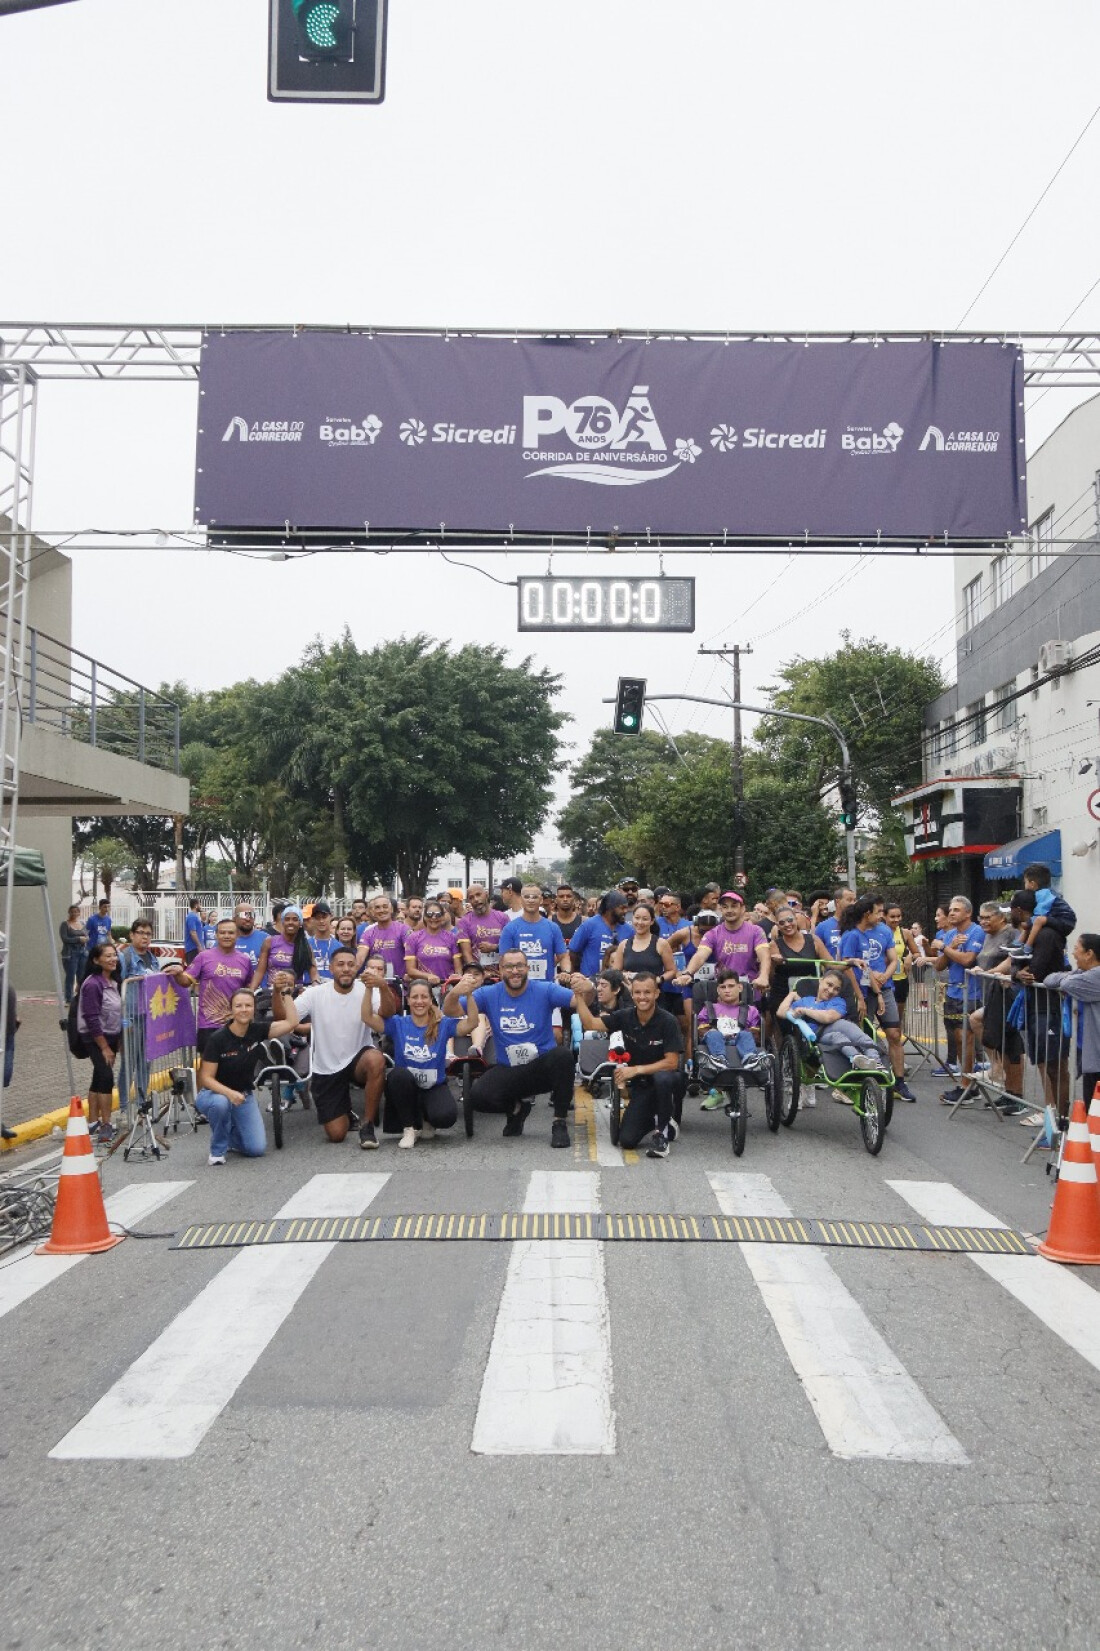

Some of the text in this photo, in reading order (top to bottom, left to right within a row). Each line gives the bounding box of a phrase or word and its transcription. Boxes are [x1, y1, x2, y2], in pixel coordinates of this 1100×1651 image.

[522, 385, 667, 450] POÁ
[574, 405, 612, 434] 76
[251, 421, 304, 431] A CASA DO
[249, 431, 302, 442] CORREDOR
[432, 422, 517, 445] Sicredi
[577, 435, 607, 443] ANOS
[743, 428, 827, 449] Sicredi
[947, 431, 1000, 441] A CASA DO
[945, 441, 998, 452] CORREDOR
[522, 451, 668, 463] CORRIDA DE ANIVERSÁRIO
